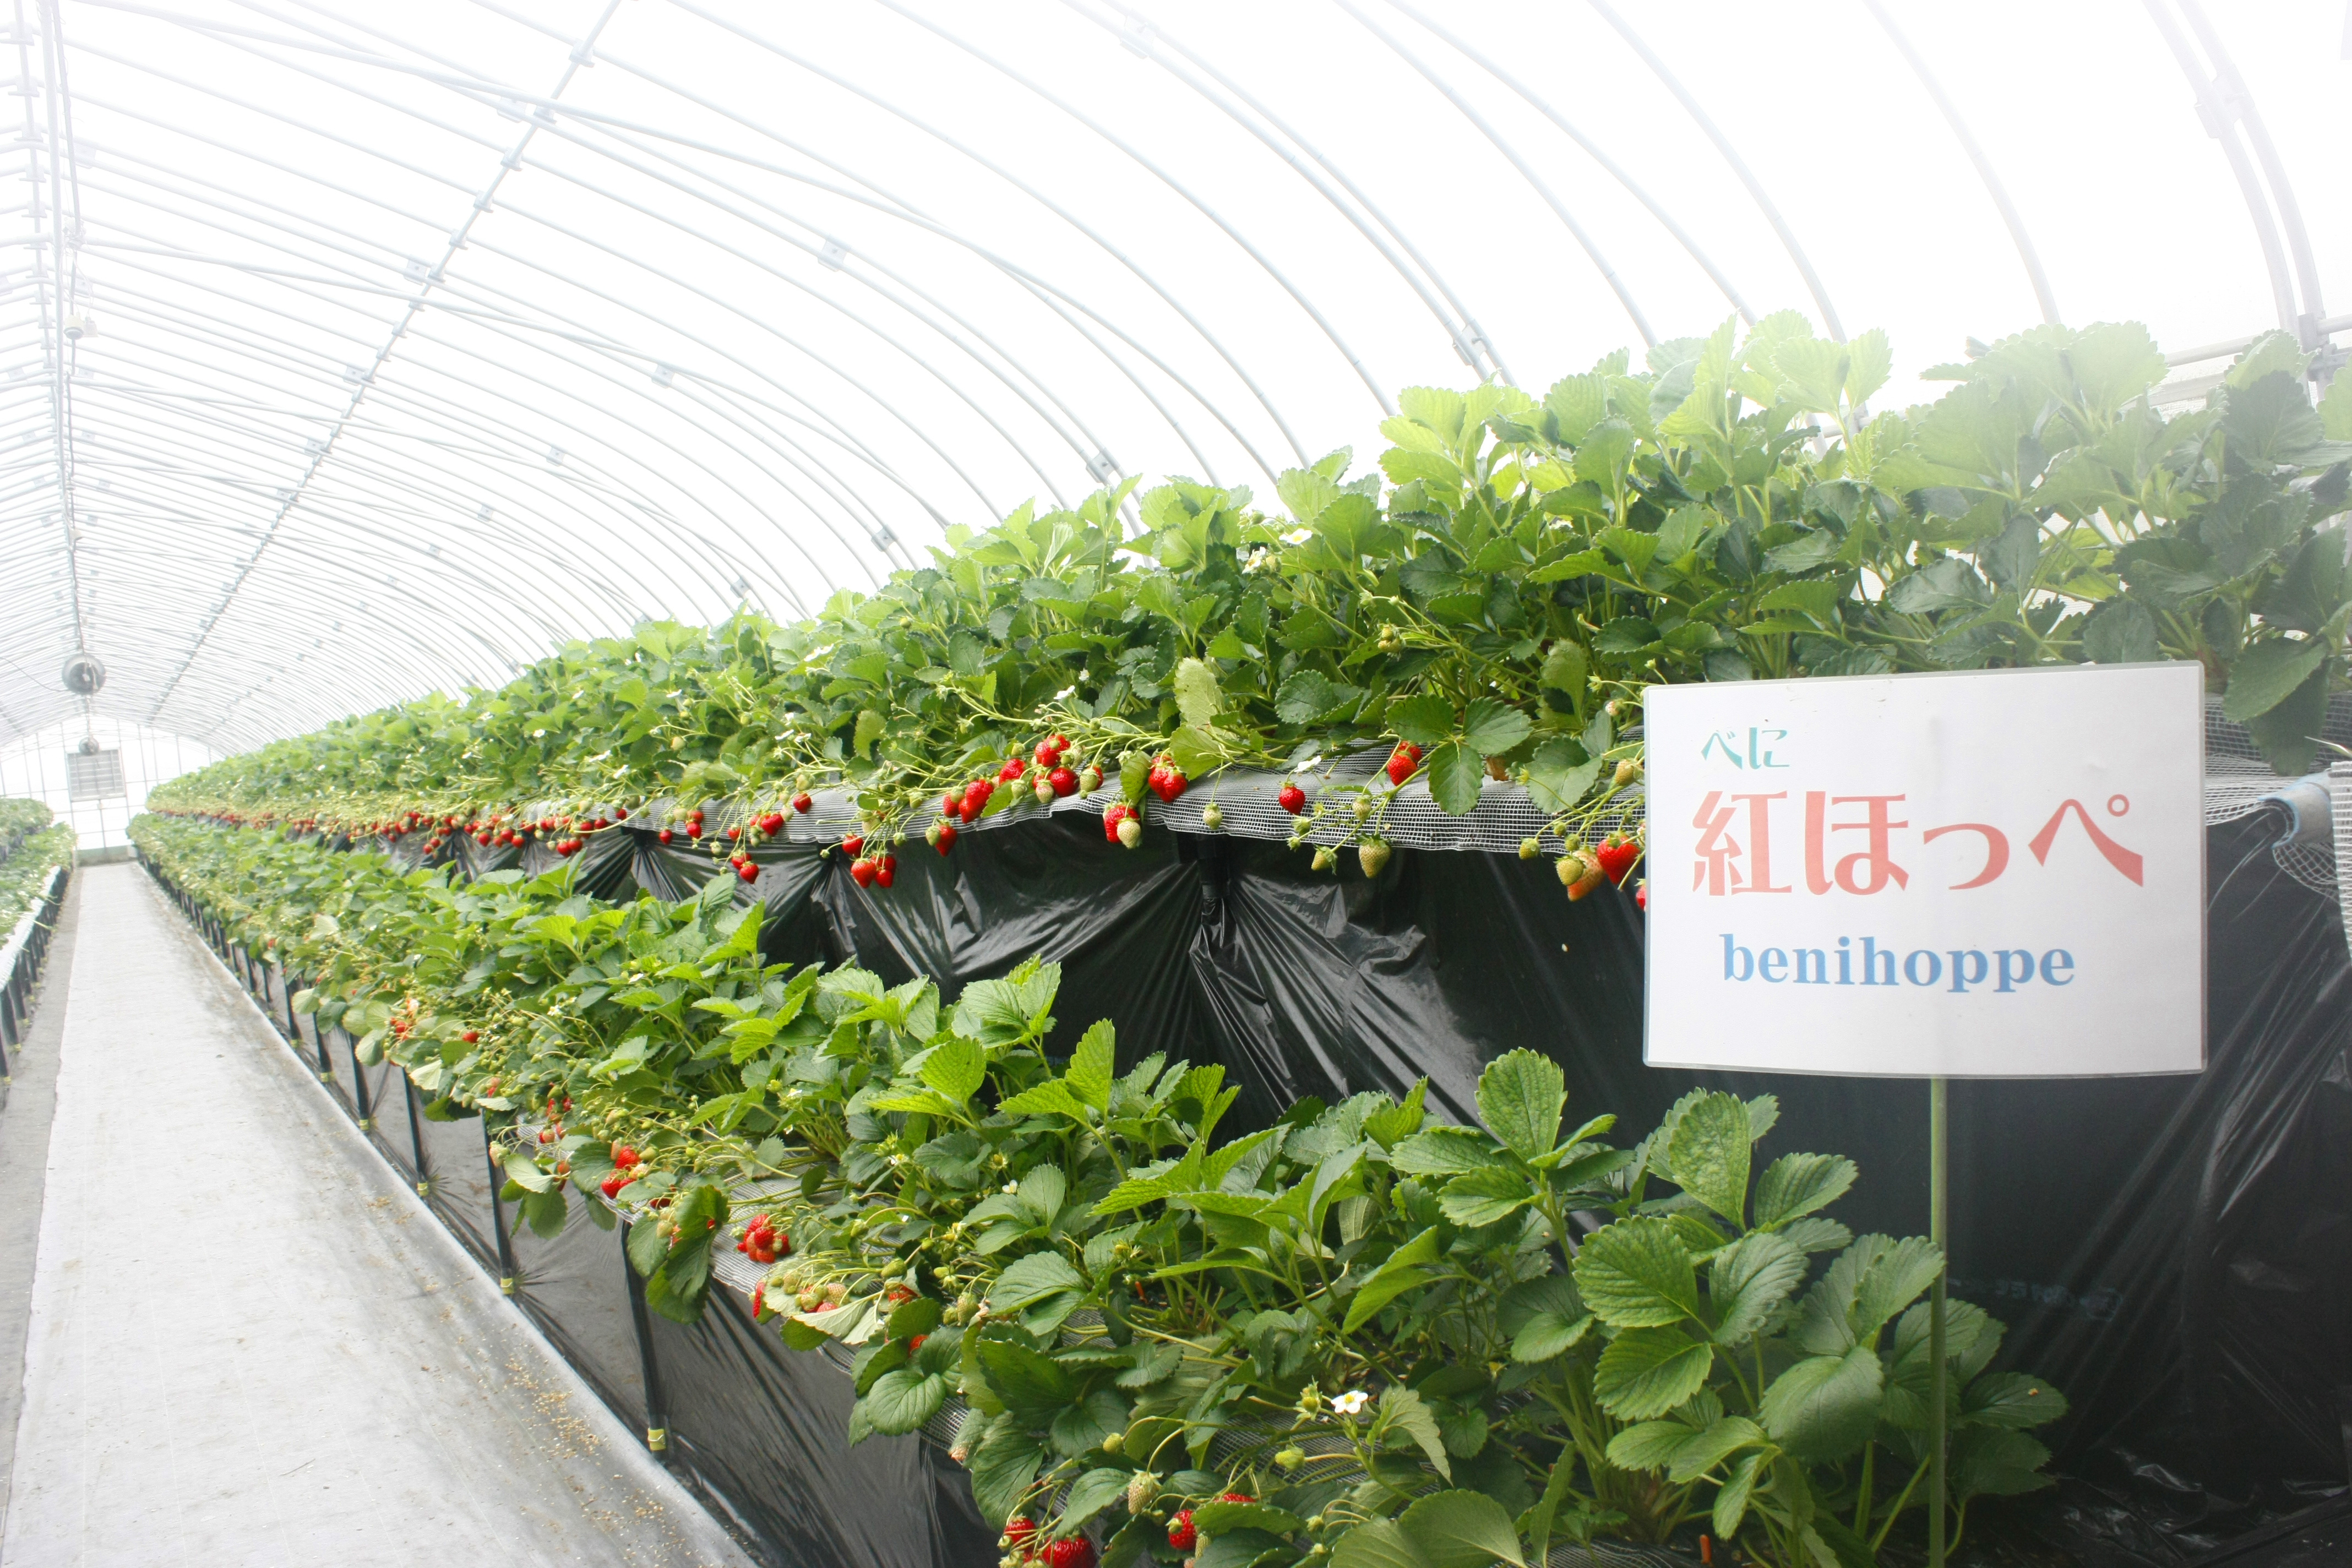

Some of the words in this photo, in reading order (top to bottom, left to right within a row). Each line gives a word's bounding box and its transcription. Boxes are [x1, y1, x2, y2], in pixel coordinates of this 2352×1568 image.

[1701, 727, 1790, 770] べに
[1692, 791, 2143, 895] 紅ほっぺ
[1719, 934, 2075, 993] benihoppe
